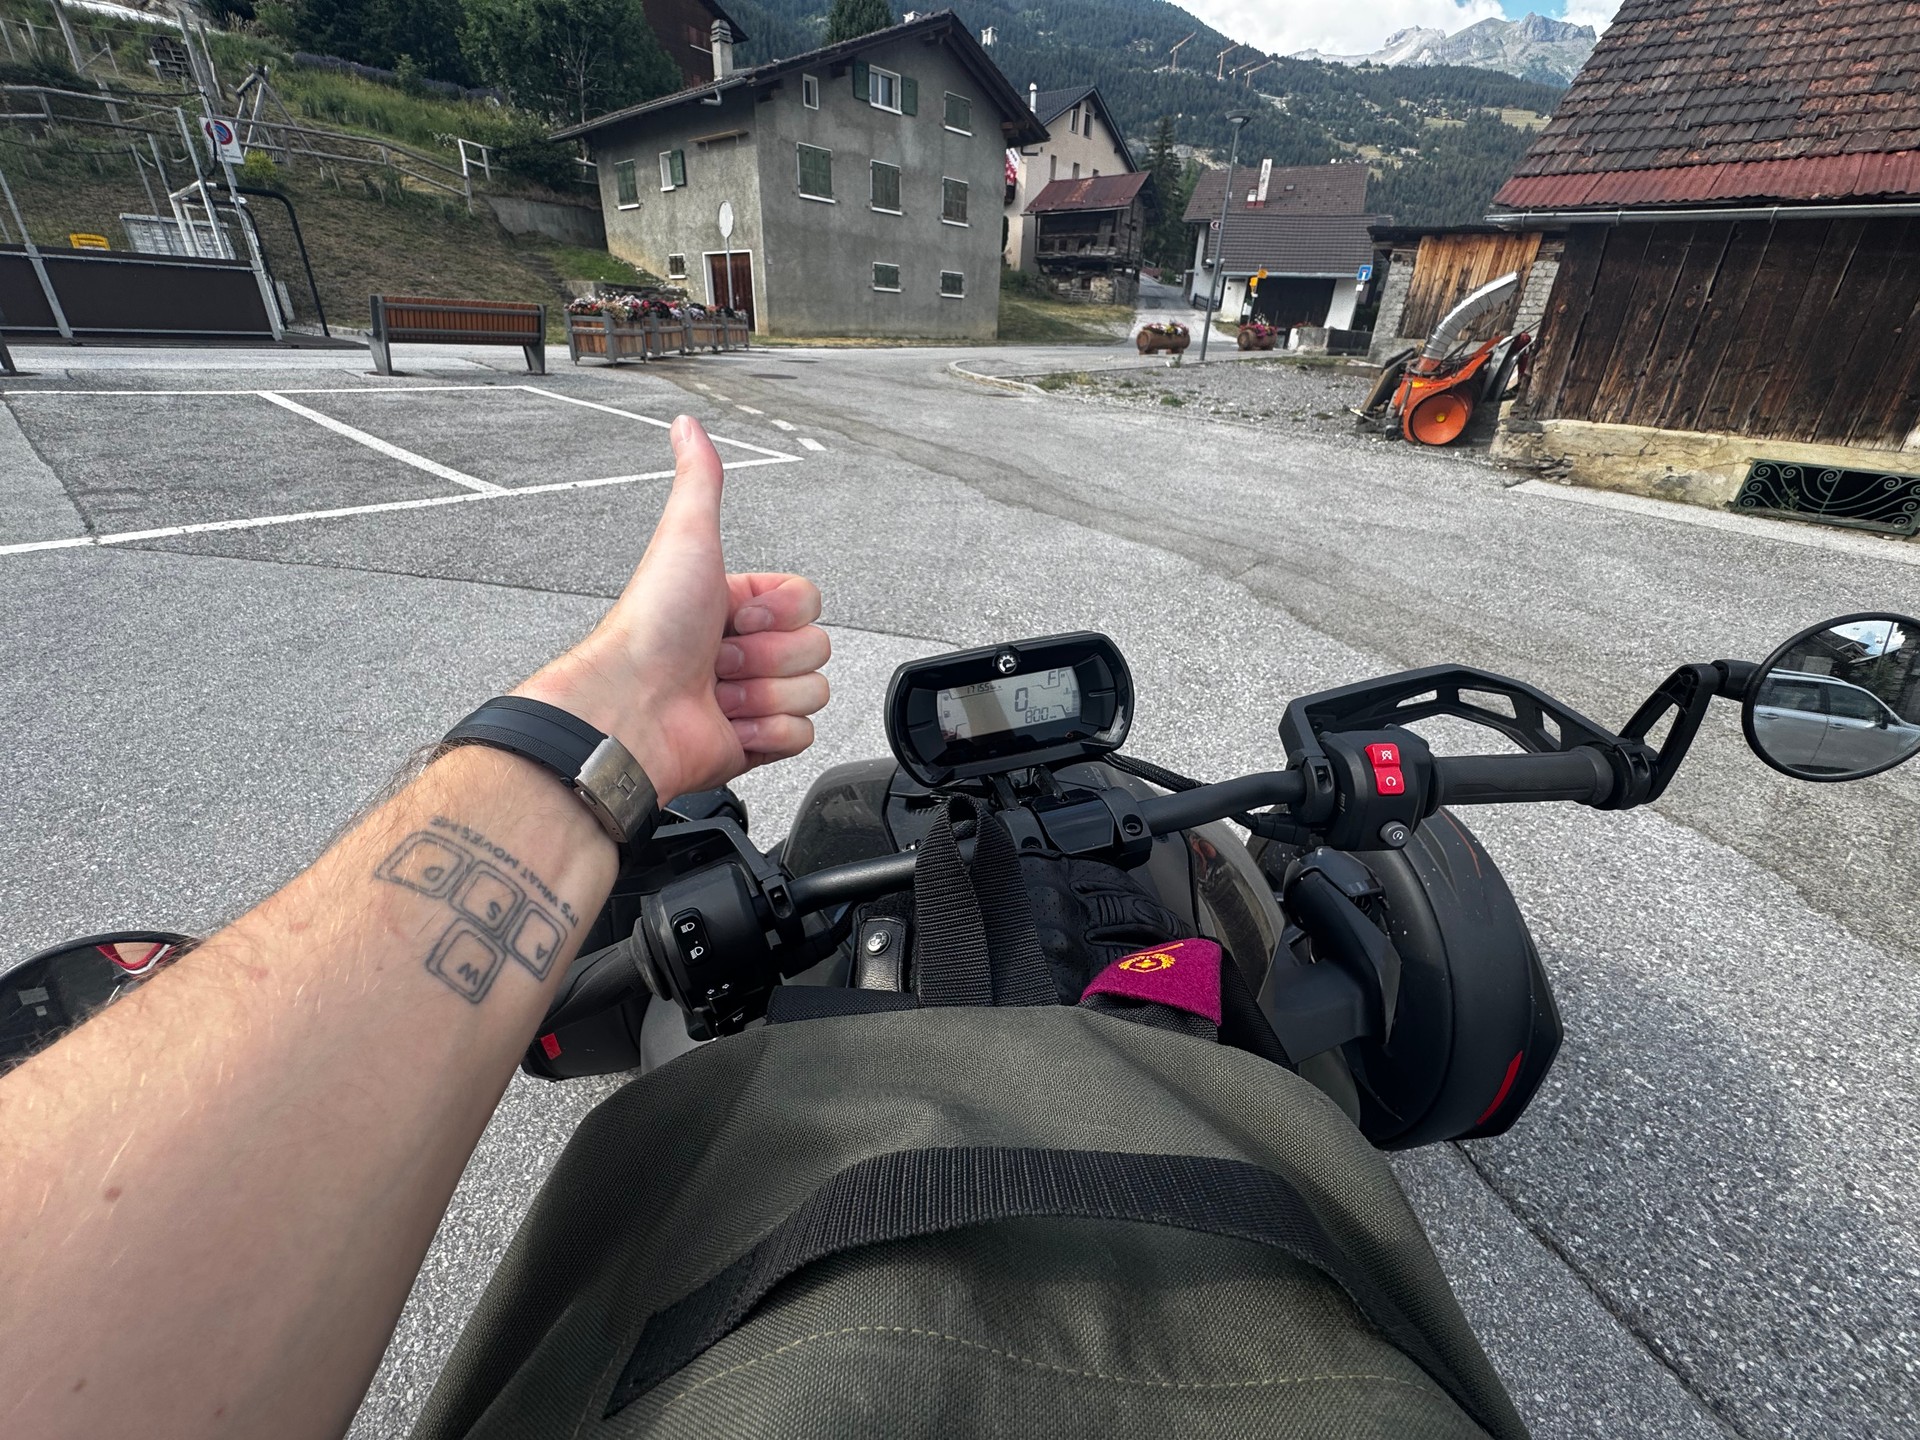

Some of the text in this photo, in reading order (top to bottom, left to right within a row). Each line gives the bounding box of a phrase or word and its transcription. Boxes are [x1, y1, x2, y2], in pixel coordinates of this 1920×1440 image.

[1014, 687, 1029, 712] 0
[1025, 706, 1049, 724] 800
[460, 826, 520, 869] MOVES
[520, 867, 560, 907] WHAT
[422, 866, 550, 960] A S D
[457, 962, 481, 987] W
